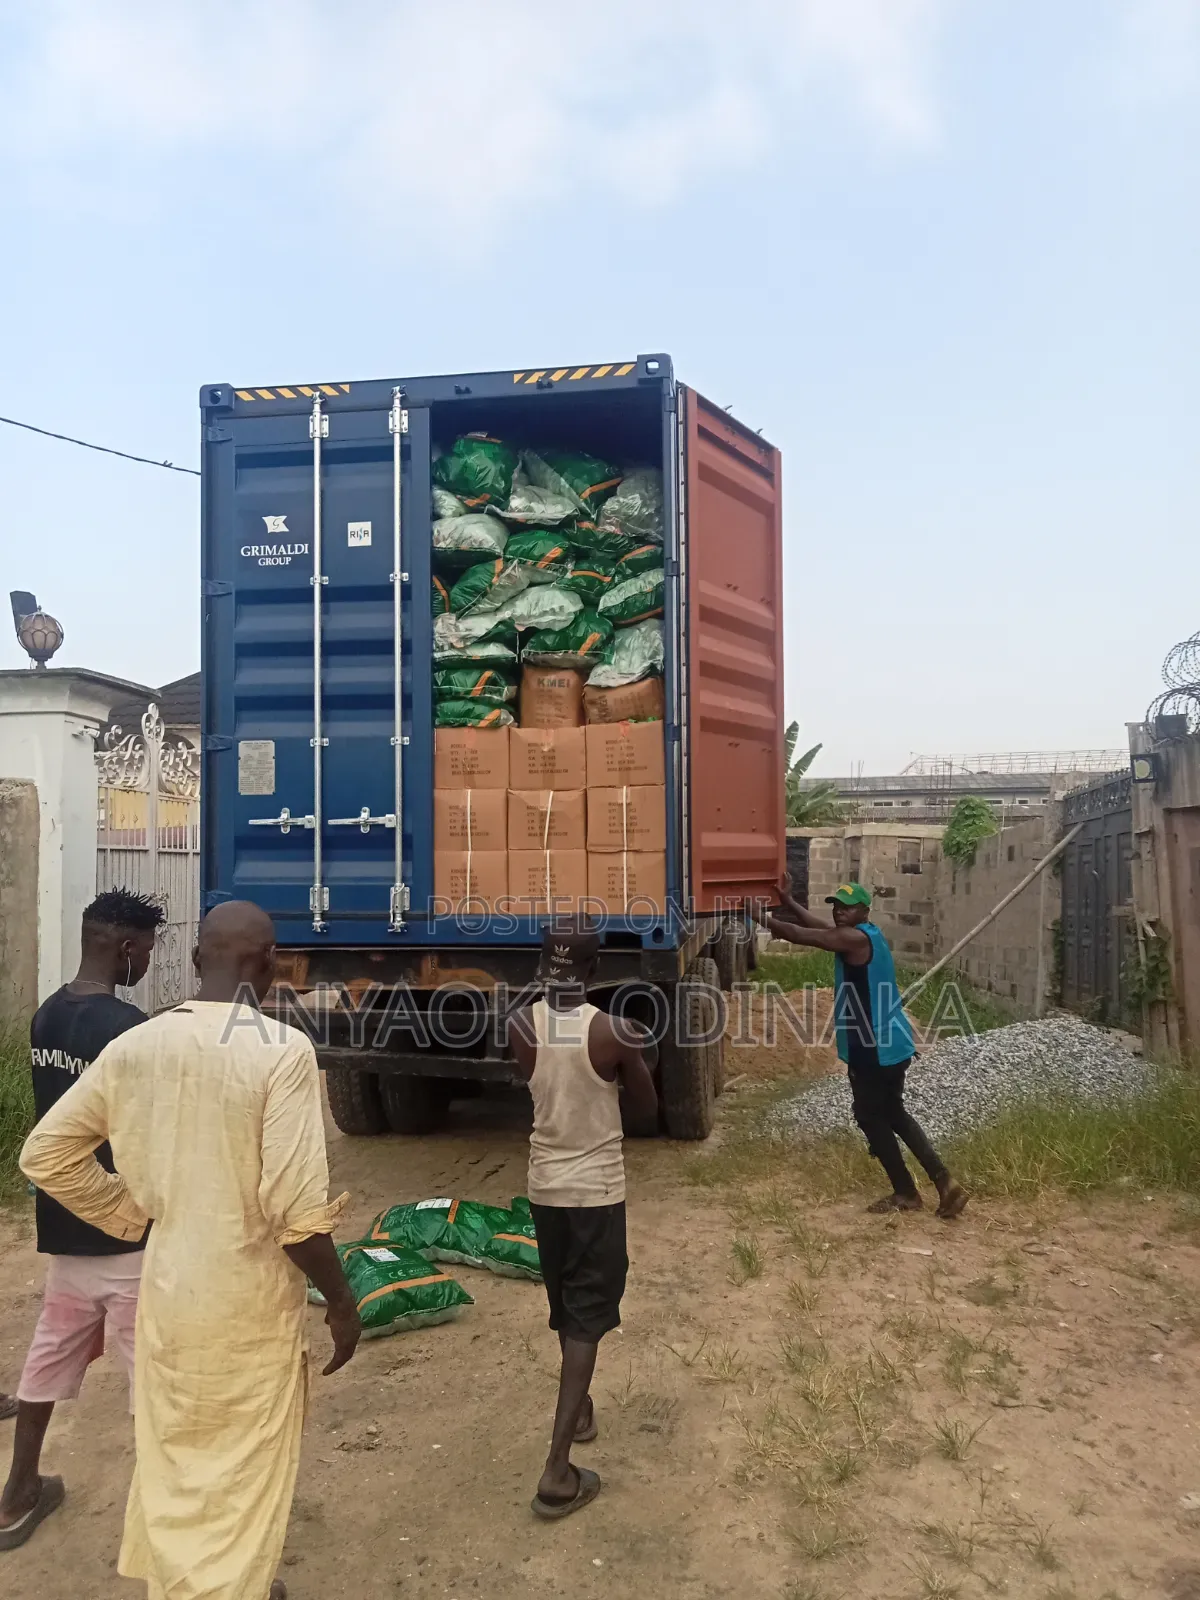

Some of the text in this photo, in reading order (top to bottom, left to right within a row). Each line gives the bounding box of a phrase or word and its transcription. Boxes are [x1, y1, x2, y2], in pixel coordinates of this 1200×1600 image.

[240, 543, 309, 557] GRIMALDI
[258, 556, 292, 566] GROUP
[550, 955, 574, 965] adidas
